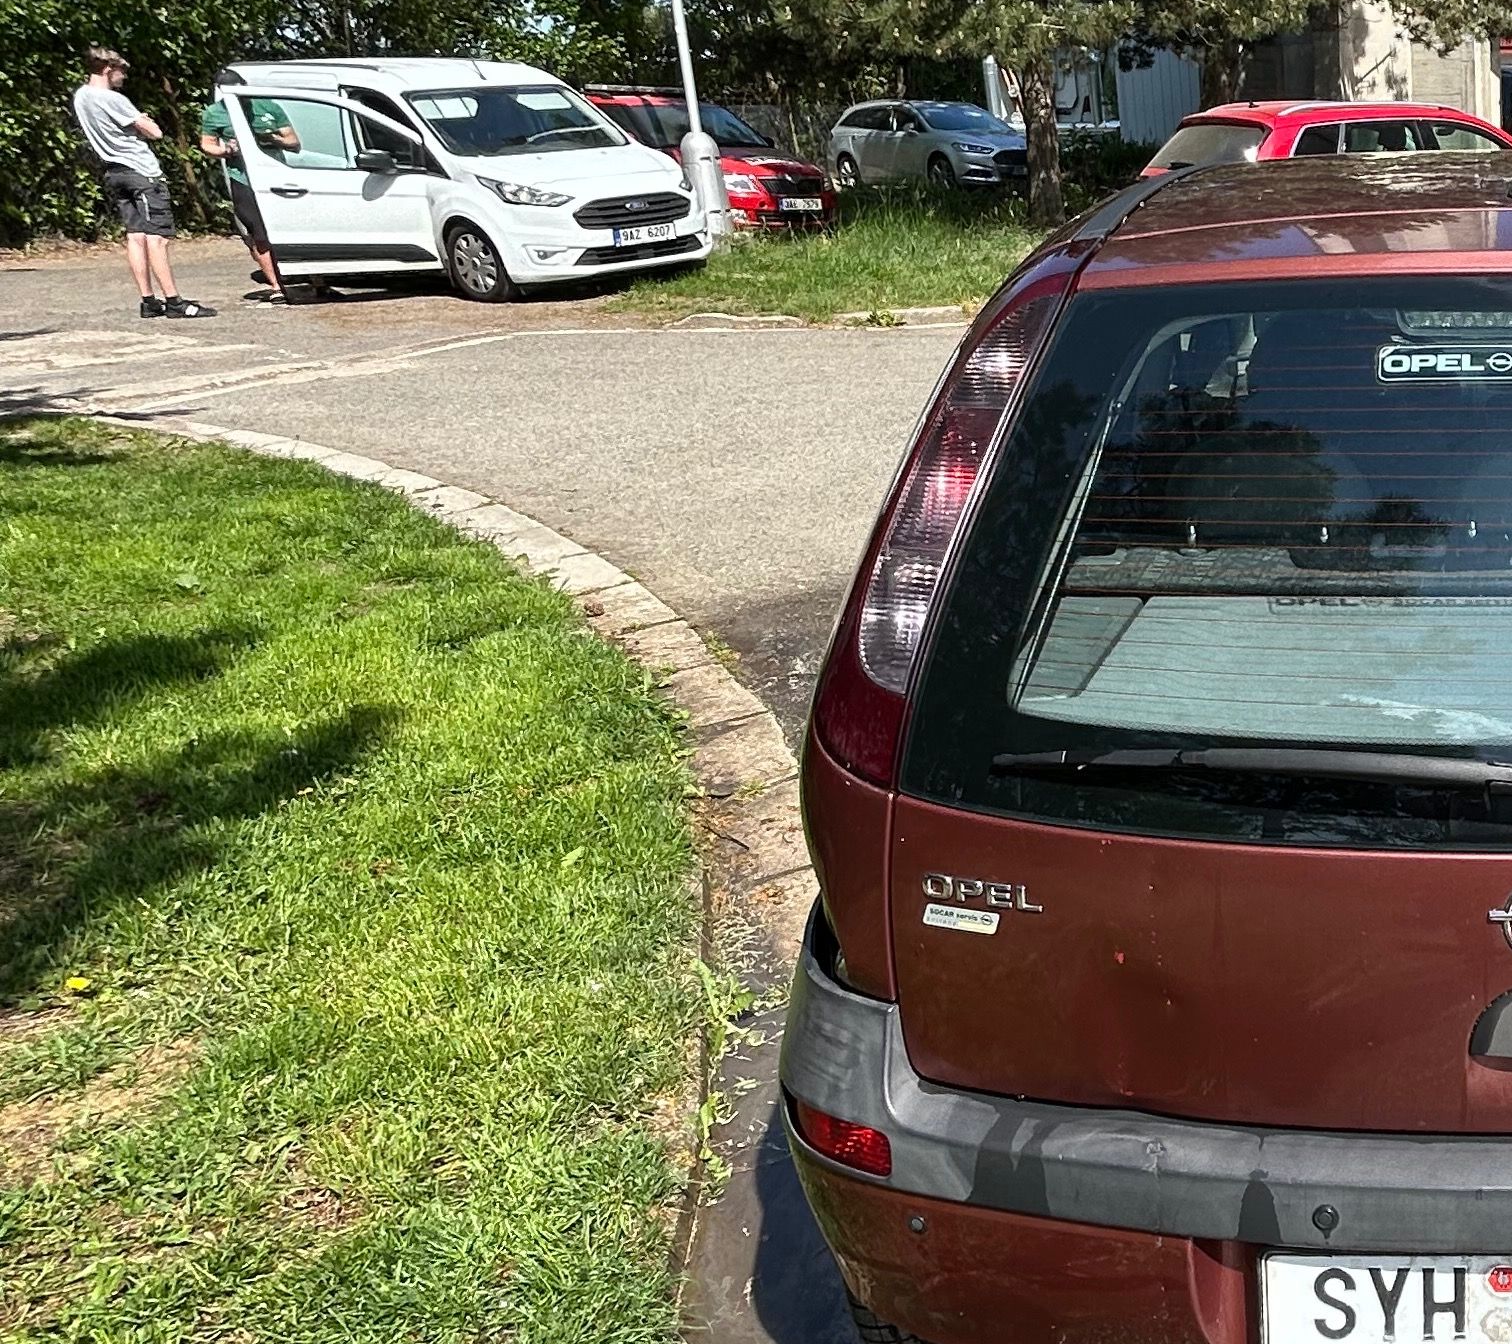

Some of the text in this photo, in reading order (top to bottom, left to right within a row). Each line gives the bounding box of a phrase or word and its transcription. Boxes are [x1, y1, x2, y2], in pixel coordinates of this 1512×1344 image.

[622, 225, 670, 241] 9AZ 6207
[1383, 353, 1485, 373] OPEL
[921, 871, 1044, 913] OPEL
[1313, 1266, 1468, 1342] SYH
